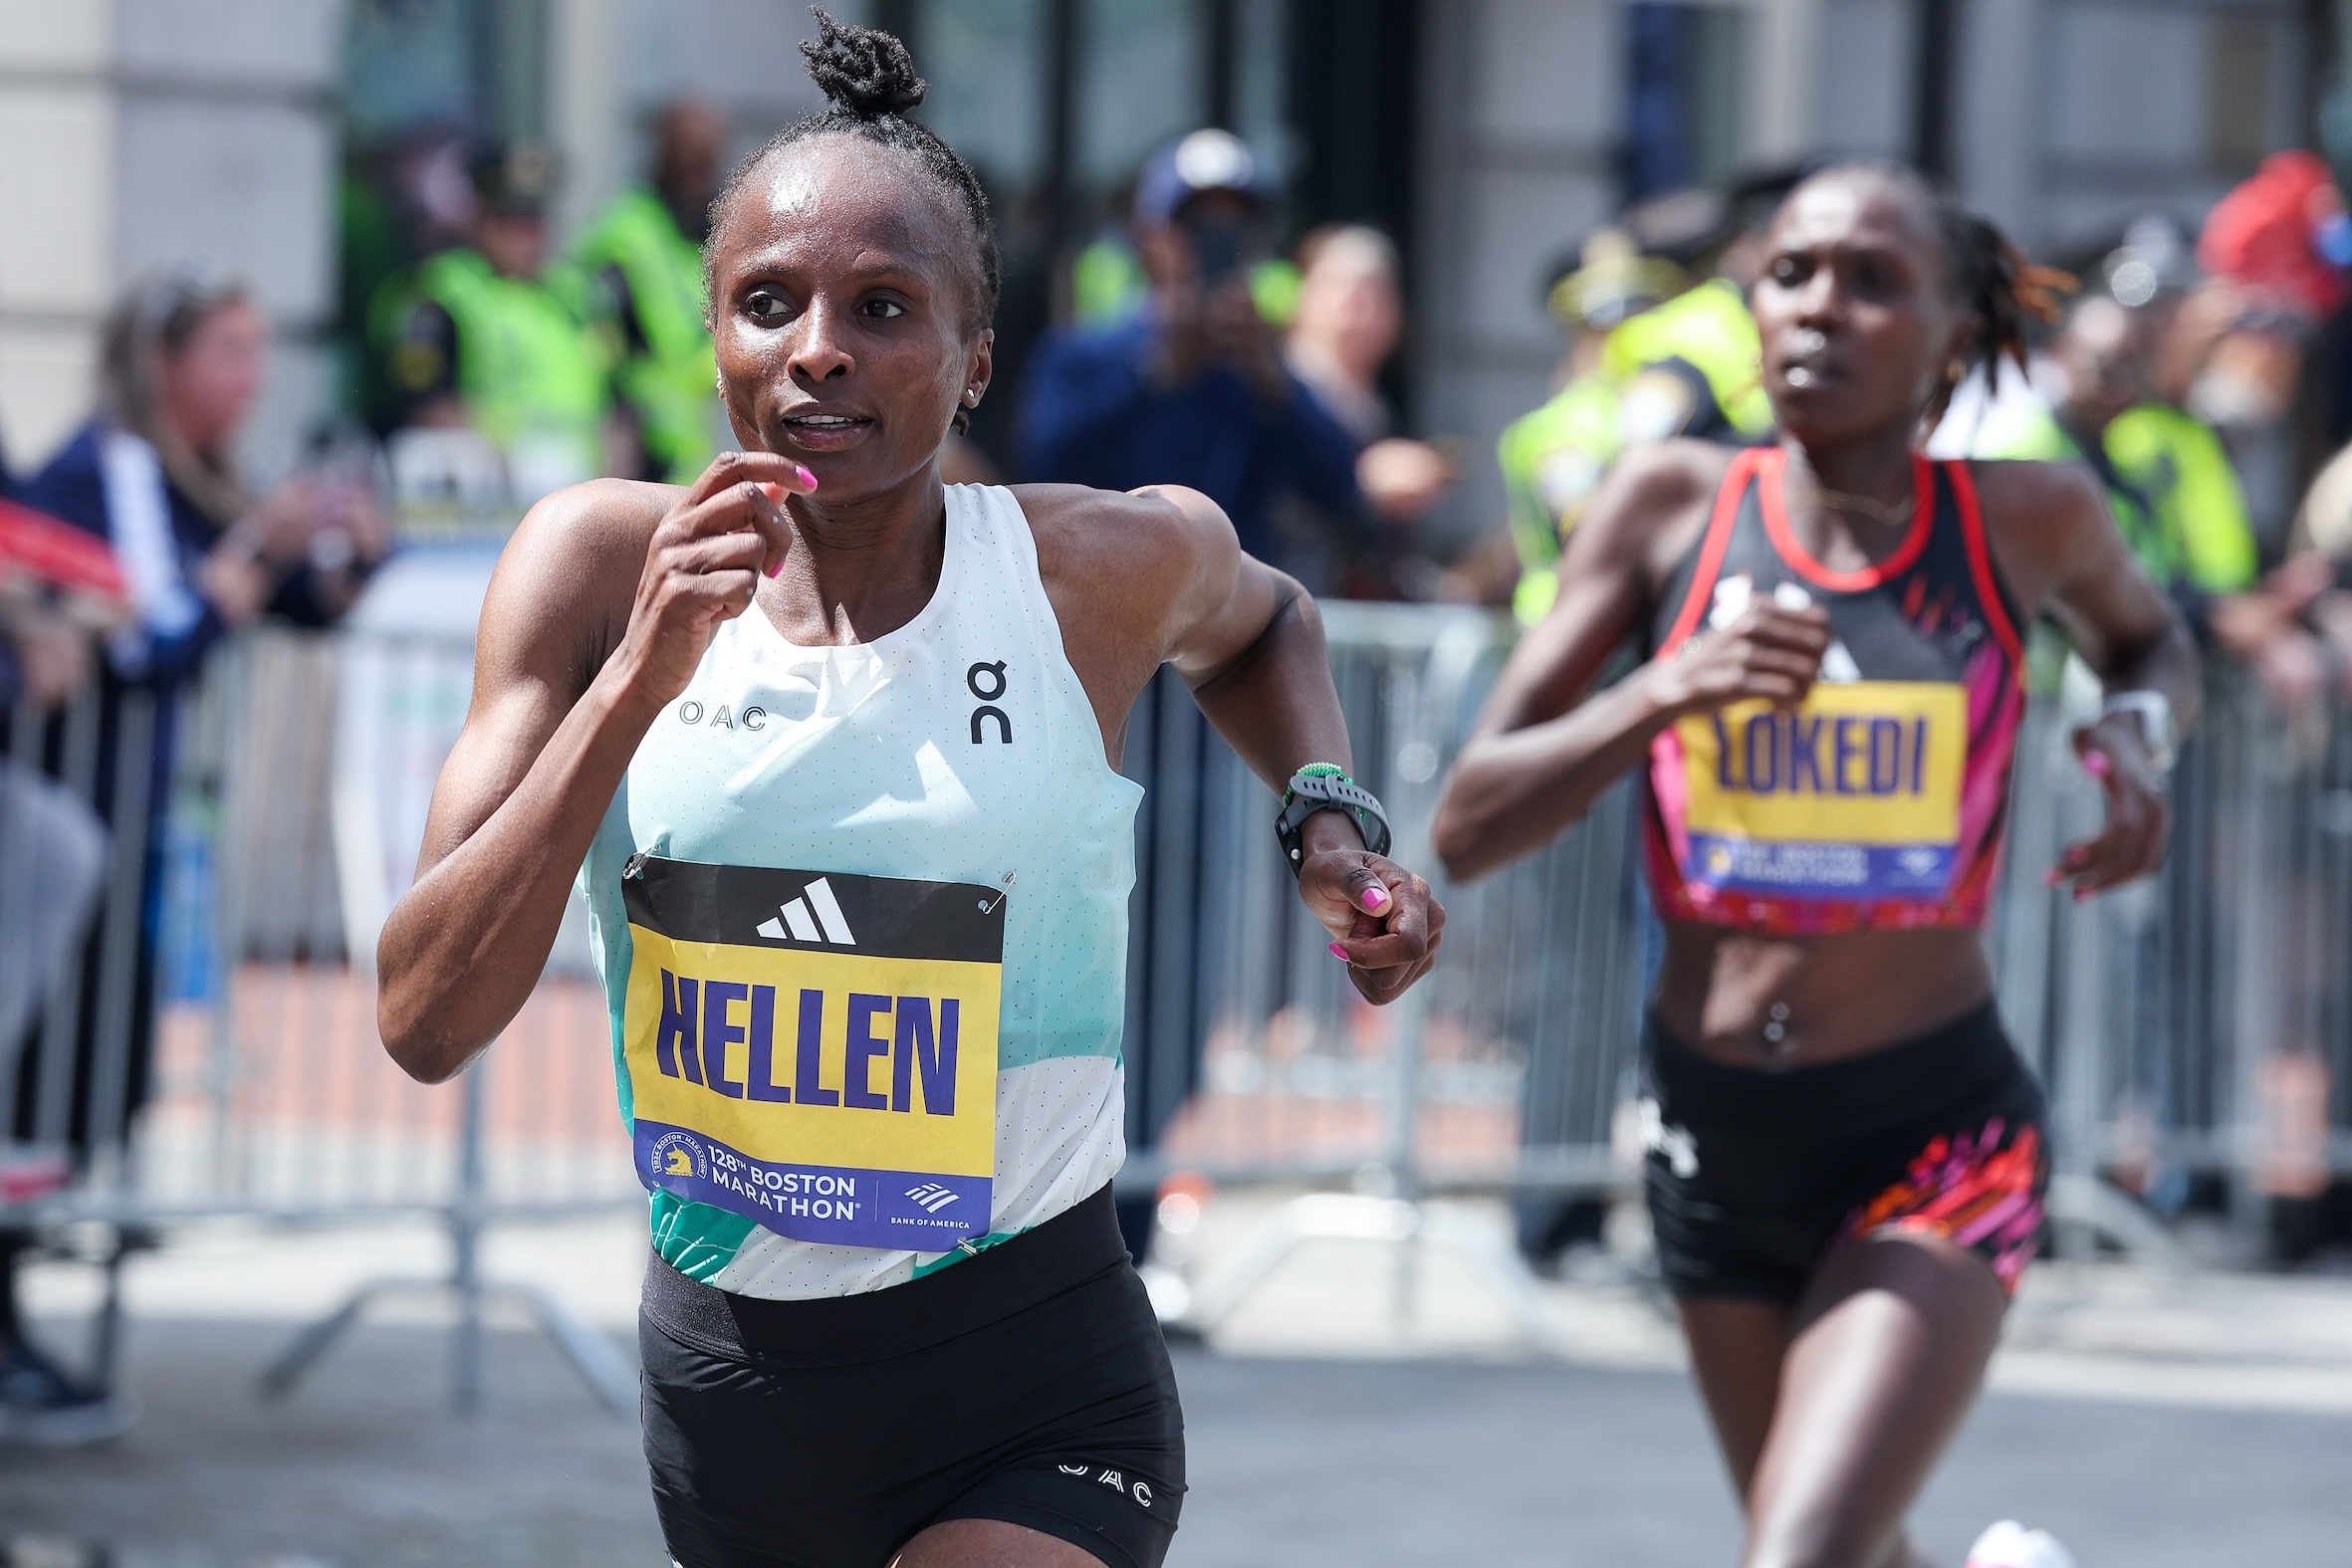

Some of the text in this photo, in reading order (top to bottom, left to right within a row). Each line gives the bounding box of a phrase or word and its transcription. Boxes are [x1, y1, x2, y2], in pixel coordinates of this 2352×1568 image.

[679, 700, 767, 732] OAC
[1715, 708, 1927, 794] LOKEDI
[655, 967, 960, 1117] HELLEN
[656, 1134, 682, 1151] BOSTON
[707, 1144, 855, 1198] 128TH BOSTON
[890, 1217, 916, 1226] BANK
[929, 1220, 971, 1230] AMERICA
